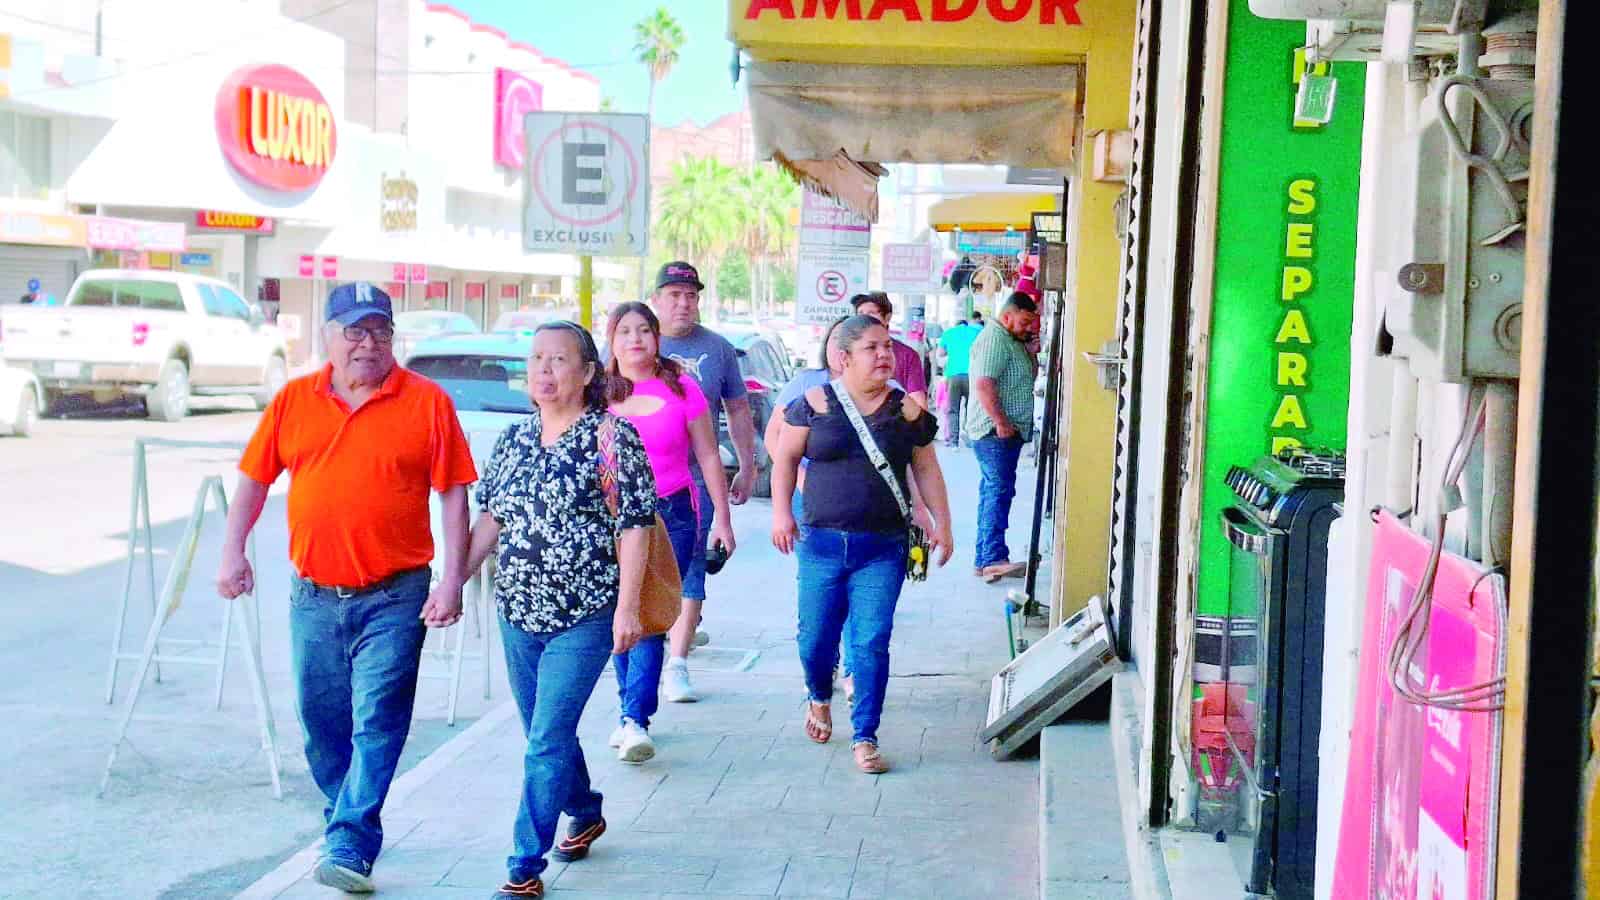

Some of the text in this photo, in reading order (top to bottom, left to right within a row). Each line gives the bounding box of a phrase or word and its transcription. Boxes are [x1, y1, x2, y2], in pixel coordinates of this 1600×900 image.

[745, 0, 1083, 25] AMADOR
[248, 85, 332, 168] LUXOR
[561, 143, 607, 205] E
[205, 211, 259, 230] LUXOR
